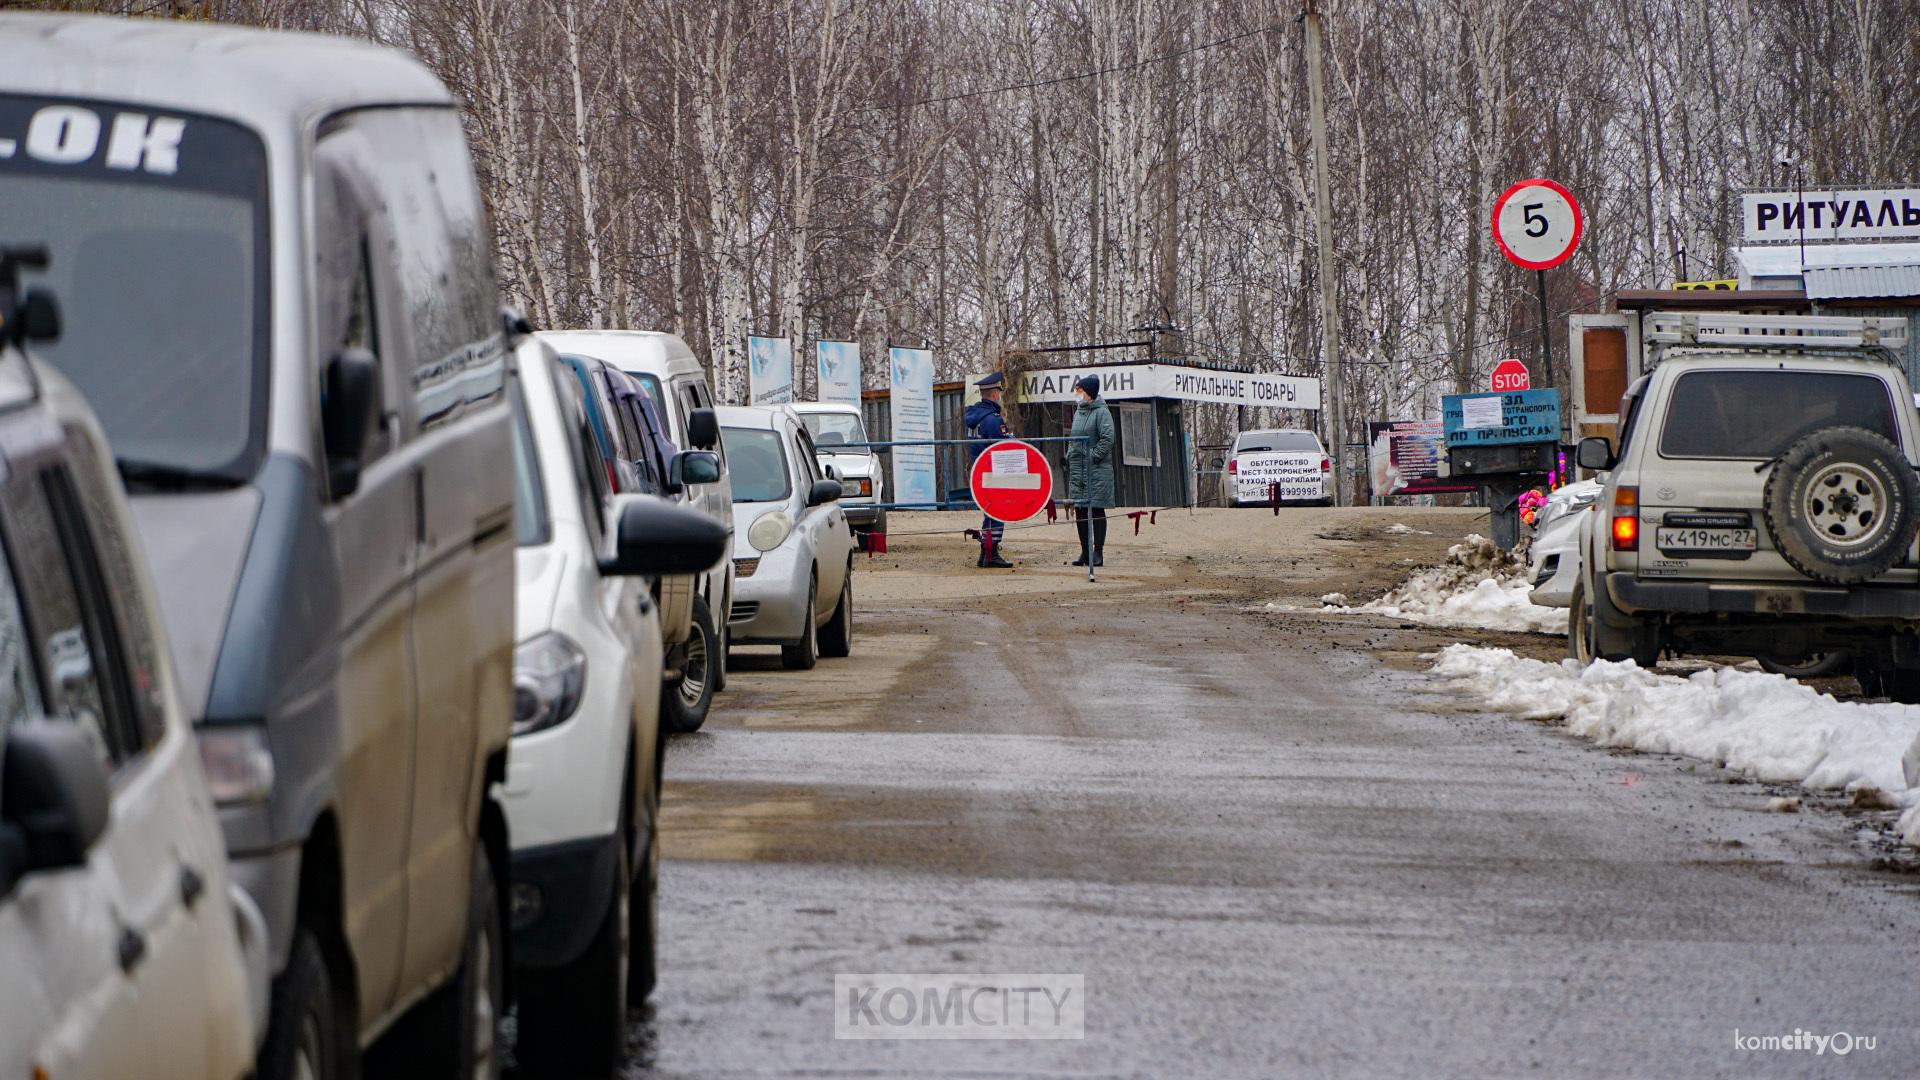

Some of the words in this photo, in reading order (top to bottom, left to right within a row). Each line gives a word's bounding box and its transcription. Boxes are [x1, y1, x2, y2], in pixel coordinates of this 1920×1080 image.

[1524, 203, 1549, 238] 5
[1022, 371, 1135, 396] МАГАИН
[1175, 374, 1245, 398] РИТУАЛЬНЫЕ
[1251, 381, 1297, 402] ТОВАРЫ
[1495, 373, 1528, 389] STOP
[1250, 458, 1309, 467] ОБУСТРОЙСТВО
[1264, 467, 1318, 475] ЗАХОРОНЕНИЯ
[1280, 476, 1321, 484] МОГИЛАМИ
[1734, 530, 1751, 543] 27
